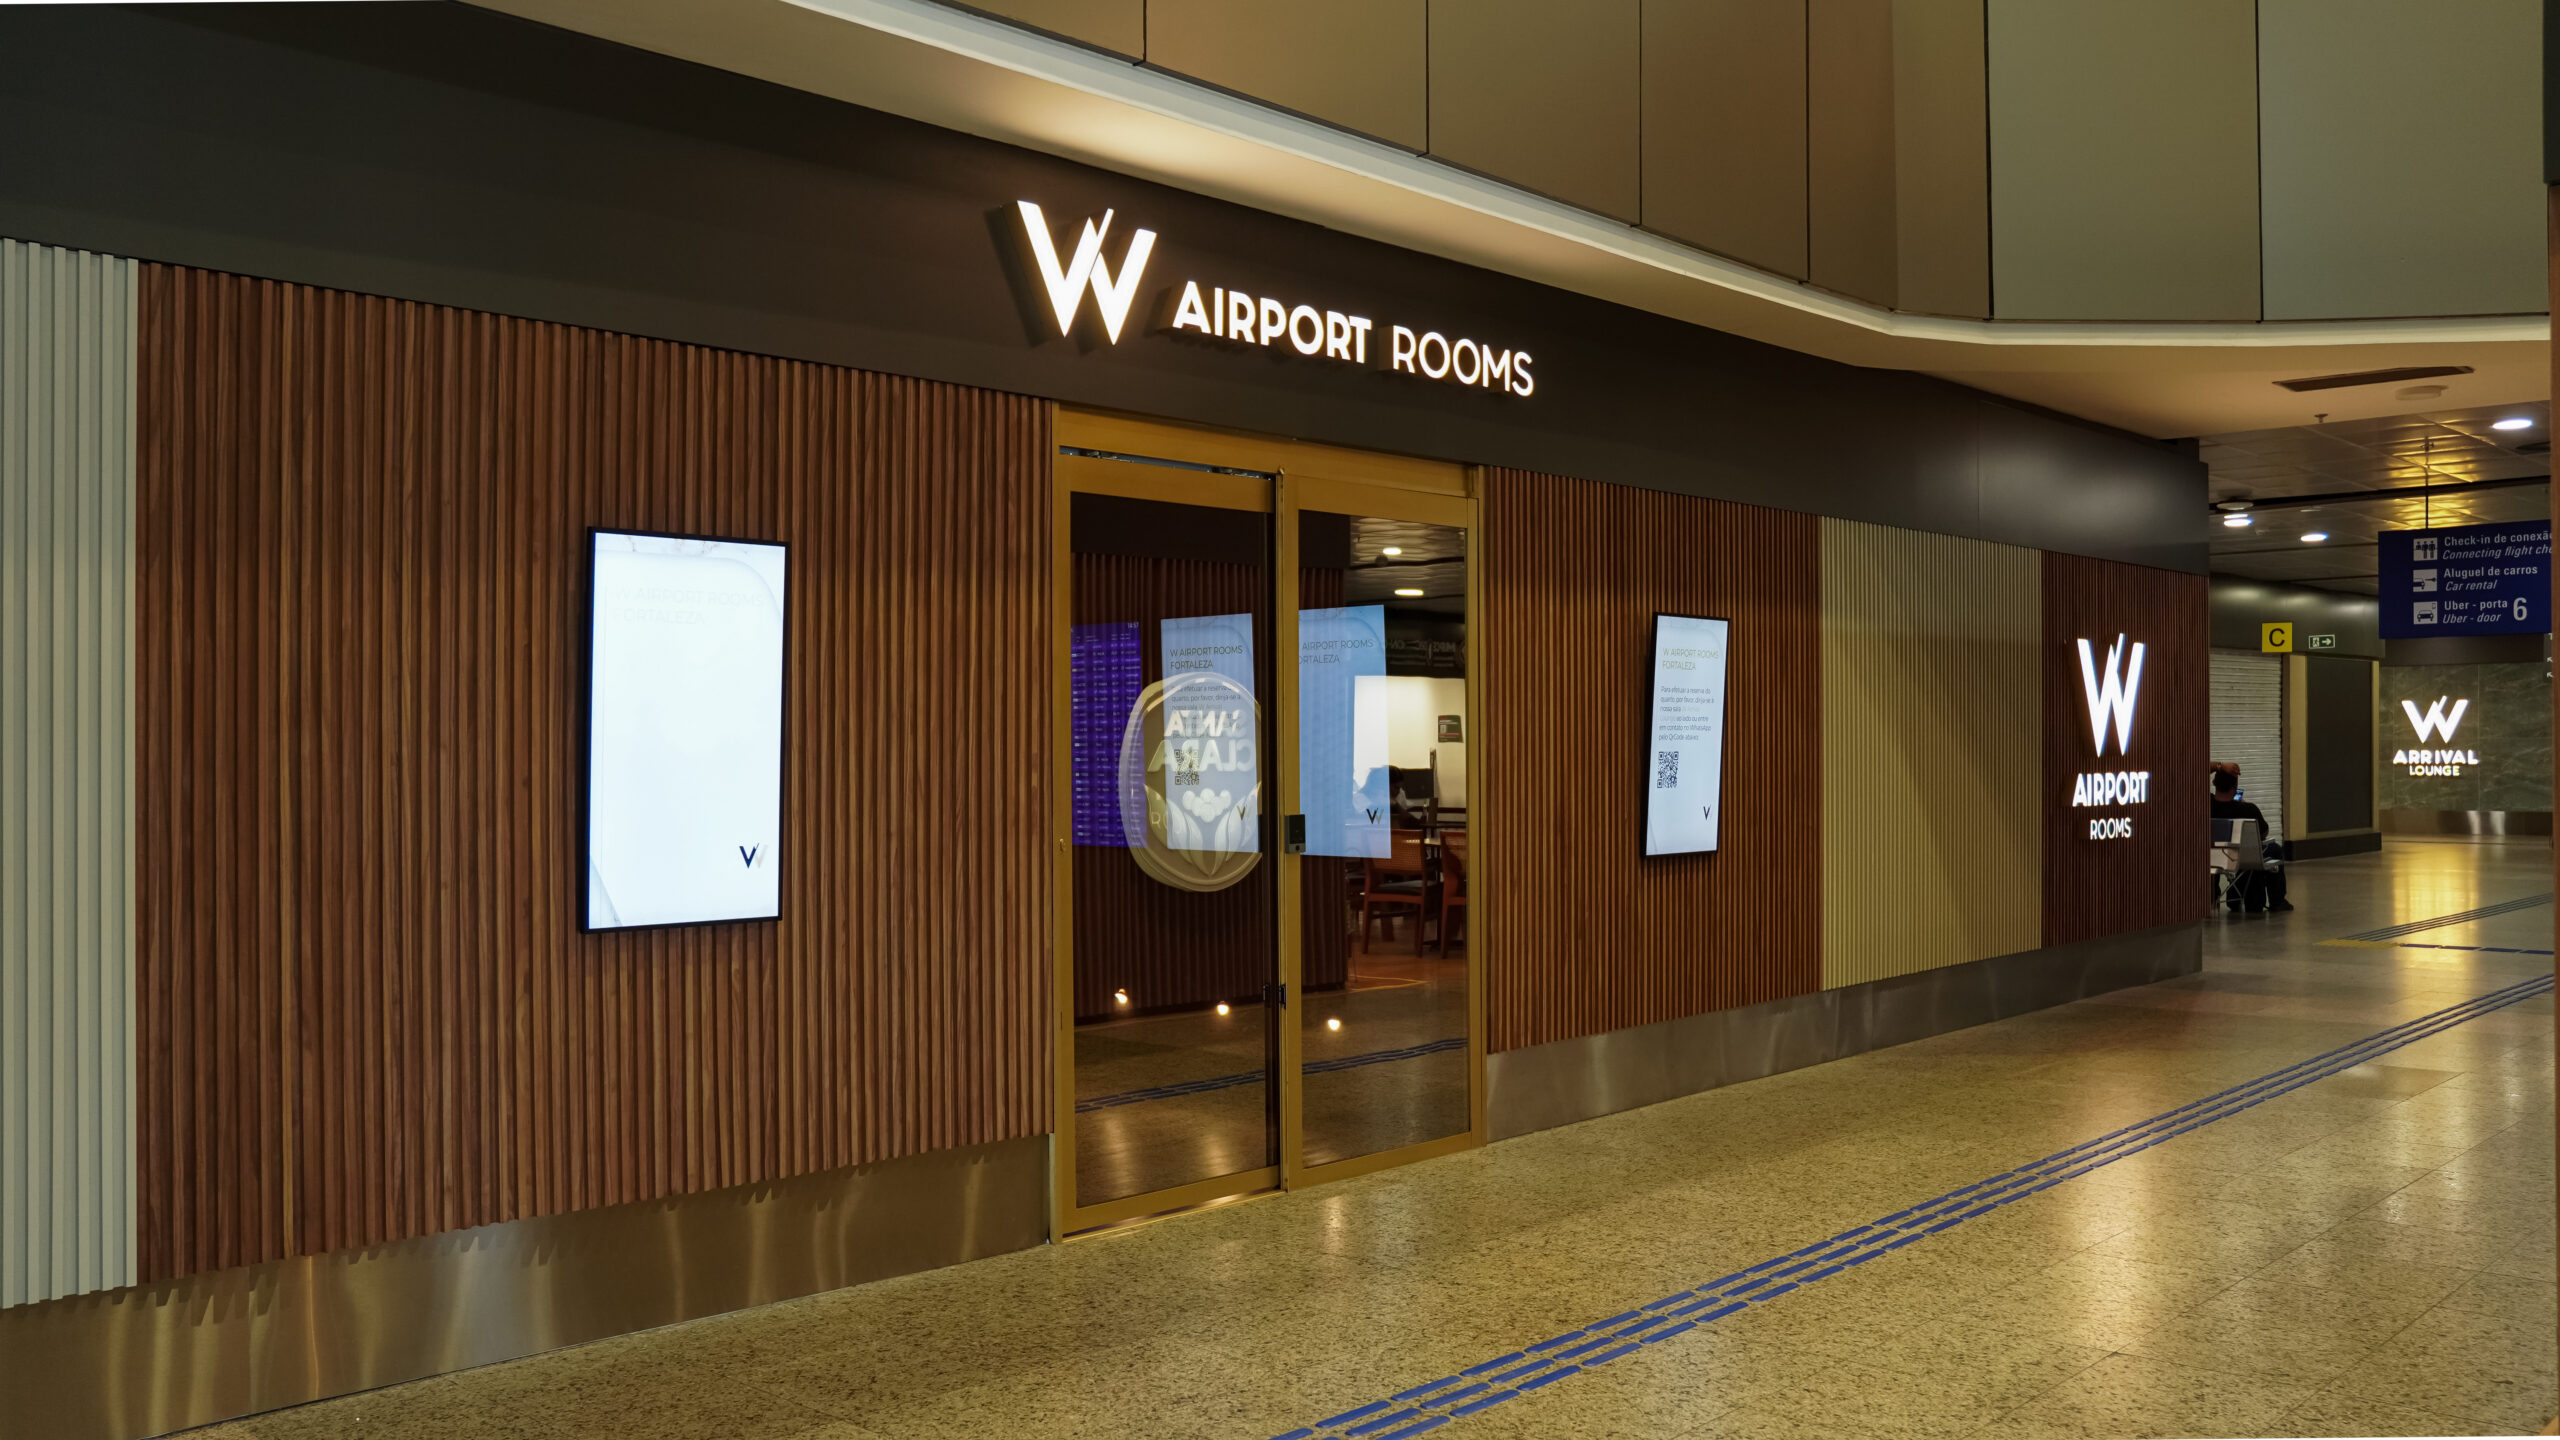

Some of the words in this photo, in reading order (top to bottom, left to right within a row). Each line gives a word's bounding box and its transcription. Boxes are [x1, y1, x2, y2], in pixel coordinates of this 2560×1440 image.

[1172, 281, 1372, 364] AIRPORT
[1392, 324, 1534, 397] ROOMS
[2444, 535, 2491, 547] Check-in
[2494, 533, 2507, 544] de
[2442, 547, 2502, 560] Connecting
[2504, 545, 2533, 557] flight
[2443, 567, 2485, 579] Aluguel
[2488, 566, 2500, 577] de
[2503, 566, 2538, 576] carros
[2445, 582, 2464, 592] Car
[2465, 580, 2498, 591] rental
[2444, 600, 2469, 611] Uber
[2479, 599, 2508, 611] porta
[2513, 597, 2528, 621] 6
[2442, 614, 2467, 624] Uber
[2477, 612, 2502, 623] door
[2269, 628, 2285, 647] C
[1170, 649, 1178, 657] W
[1179, 647, 1212, 657] AIRPORT
[1213, 645, 1243, 655] ROOMS
[1302, 640, 1339, 651] AIRPORT
[1340, 638, 1374, 649] ROOMS
[1670, 648, 1697, 658] AIRPORT
[1697, 649, 1719, 659] ROOMS
[1170, 660, 1213, 670] FORTALEZA
[1662, 660, 1696, 671] FORTALEZA
[2392, 749, 2479, 765] ARRIVAL
[2409, 765, 2460, 776] LOUNGE
[2072, 771, 2150, 807] AIRPORT
[2090, 817, 2132, 840] ROOMS
